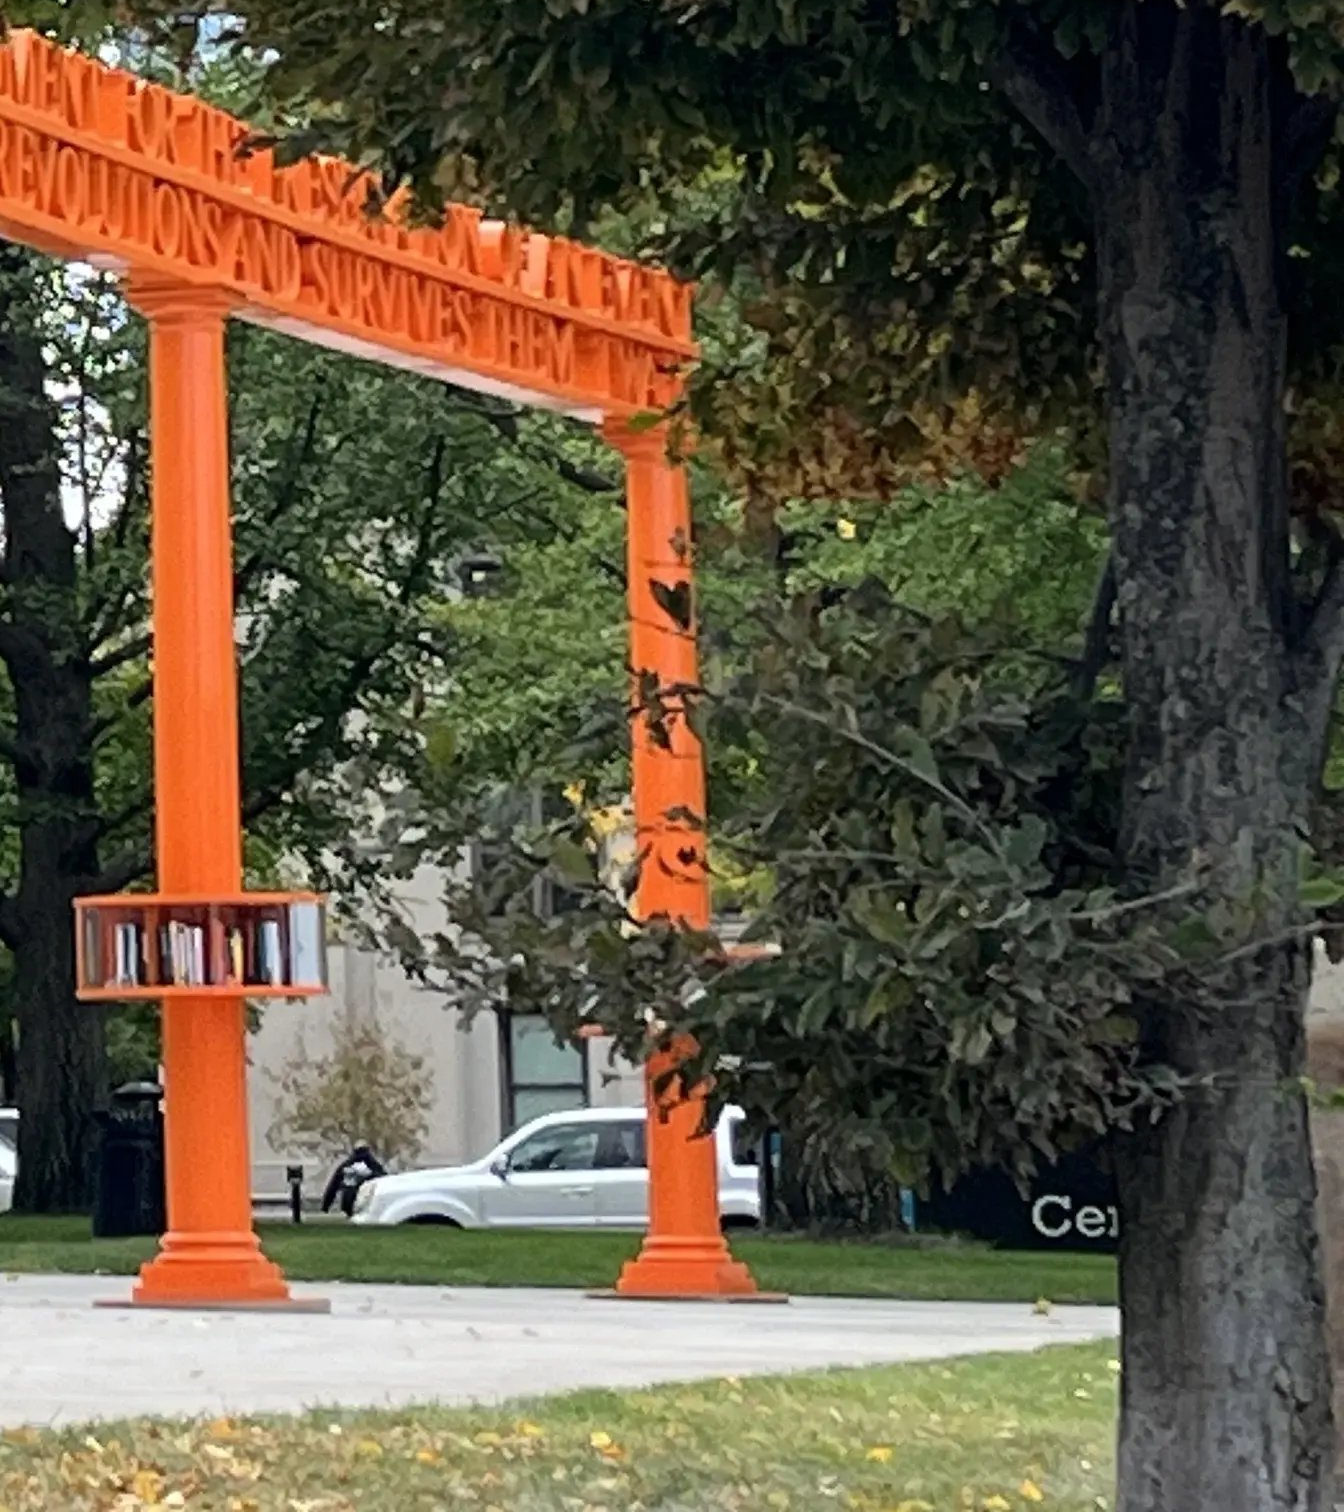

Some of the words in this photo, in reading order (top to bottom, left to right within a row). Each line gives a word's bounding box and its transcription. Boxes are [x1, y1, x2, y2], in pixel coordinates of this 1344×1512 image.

[120, 71, 180, 168] FOR
[232, 212, 302, 301] AND
[311, 241, 474, 358] SURVIVES
[480, 296, 577, 387] THEM
